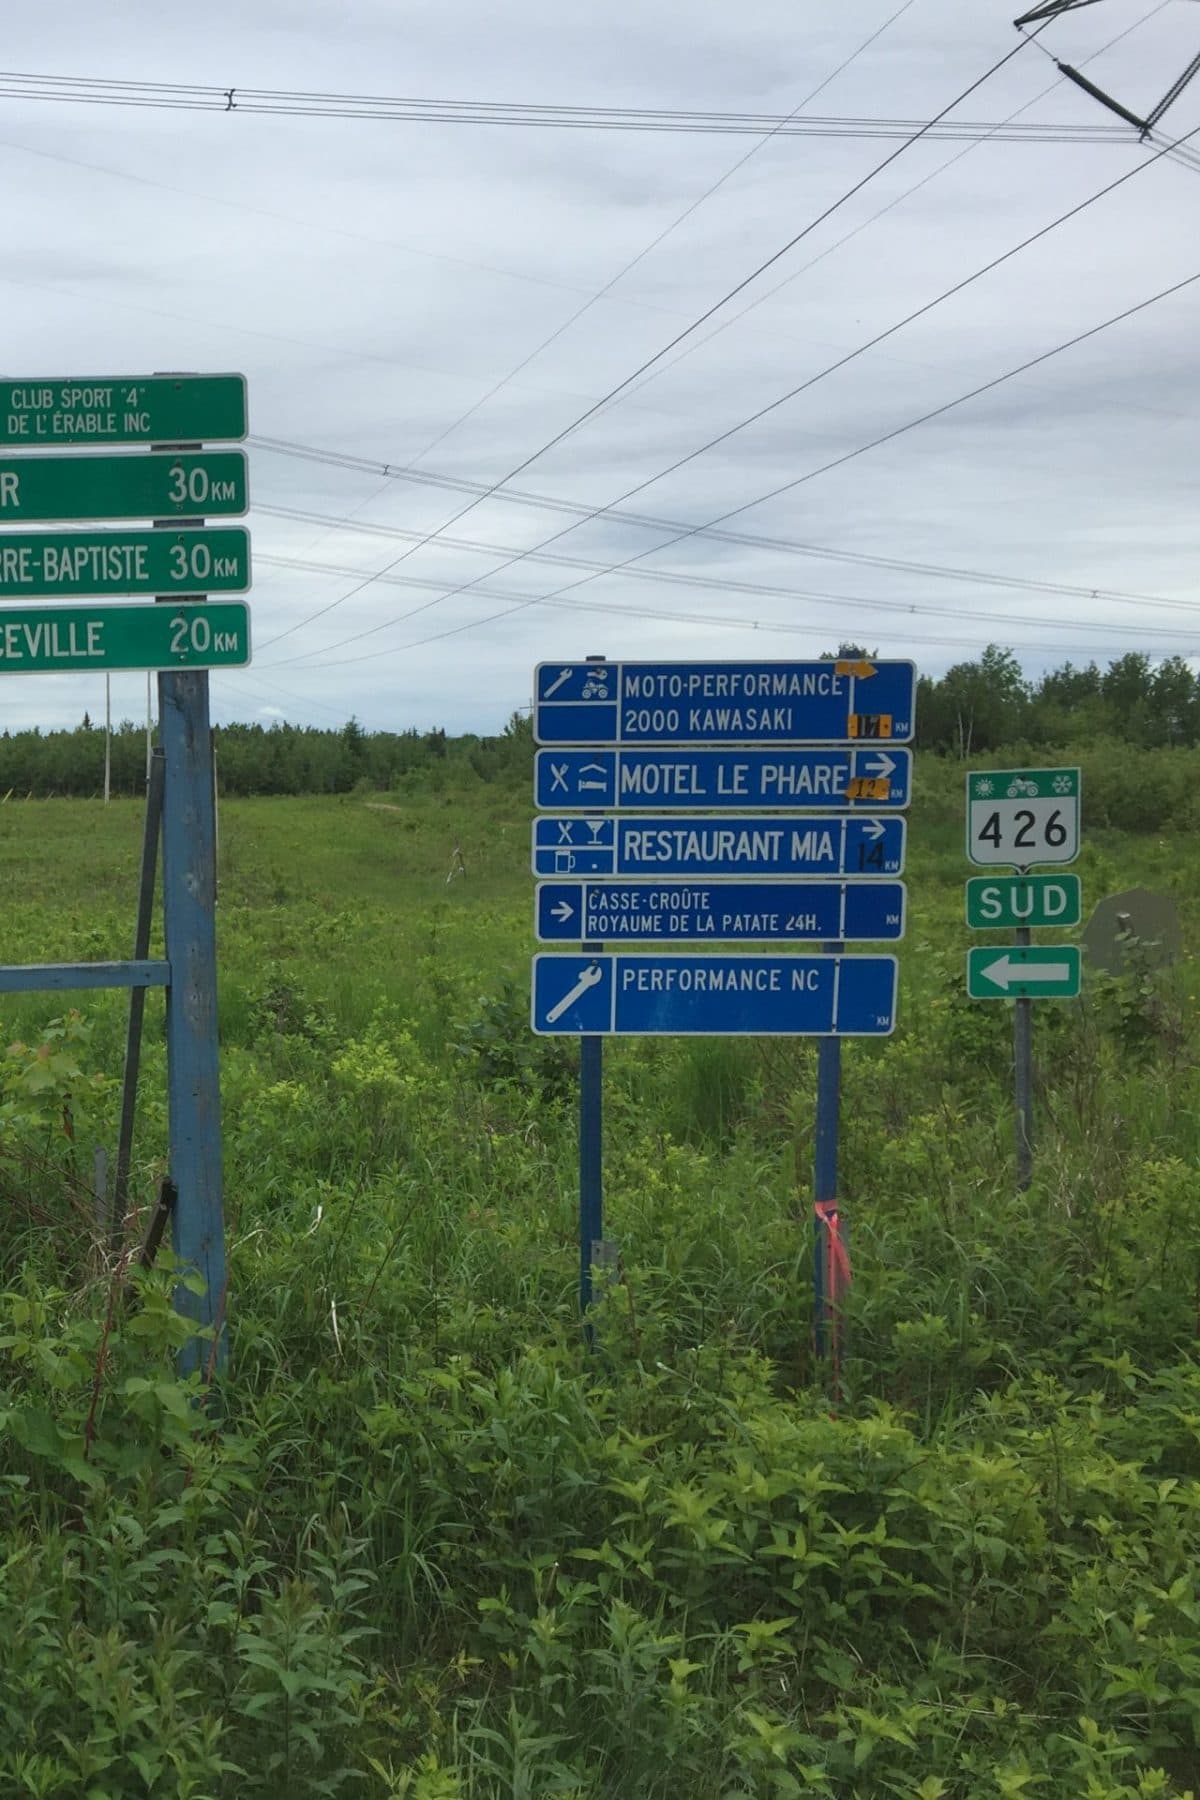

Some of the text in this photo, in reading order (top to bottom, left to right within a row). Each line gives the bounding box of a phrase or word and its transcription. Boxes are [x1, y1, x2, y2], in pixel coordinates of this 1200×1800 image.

[11, 389, 54, 409] CLUB
[61, 387, 113, 408] SPORT
[7, 414, 29, 434] DE
[124, 412, 150, 432] INC
[625, 673, 843, 699] MOTO-PERFORMANCE
[625, 708, 793, 733] 2000 KAWASAKI
[621, 763, 848, 795] MOTEL LE PHARE
[978, 809, 1067, 849] 426
[624, 831, 834, 861] RESTAURANT MIA
[588, 888, 711, 910] CASSE-CROÛTE
[980, 885, 1067, 919] SUD
[588, 915, 662, 932] ROYAUME
[670, 915, 688, 931] DE
[697, 915, 715, 931] LA
[723, 914, 779, 931] PATATE
[623, 969, 820, 991] PERFORMANCE NC
